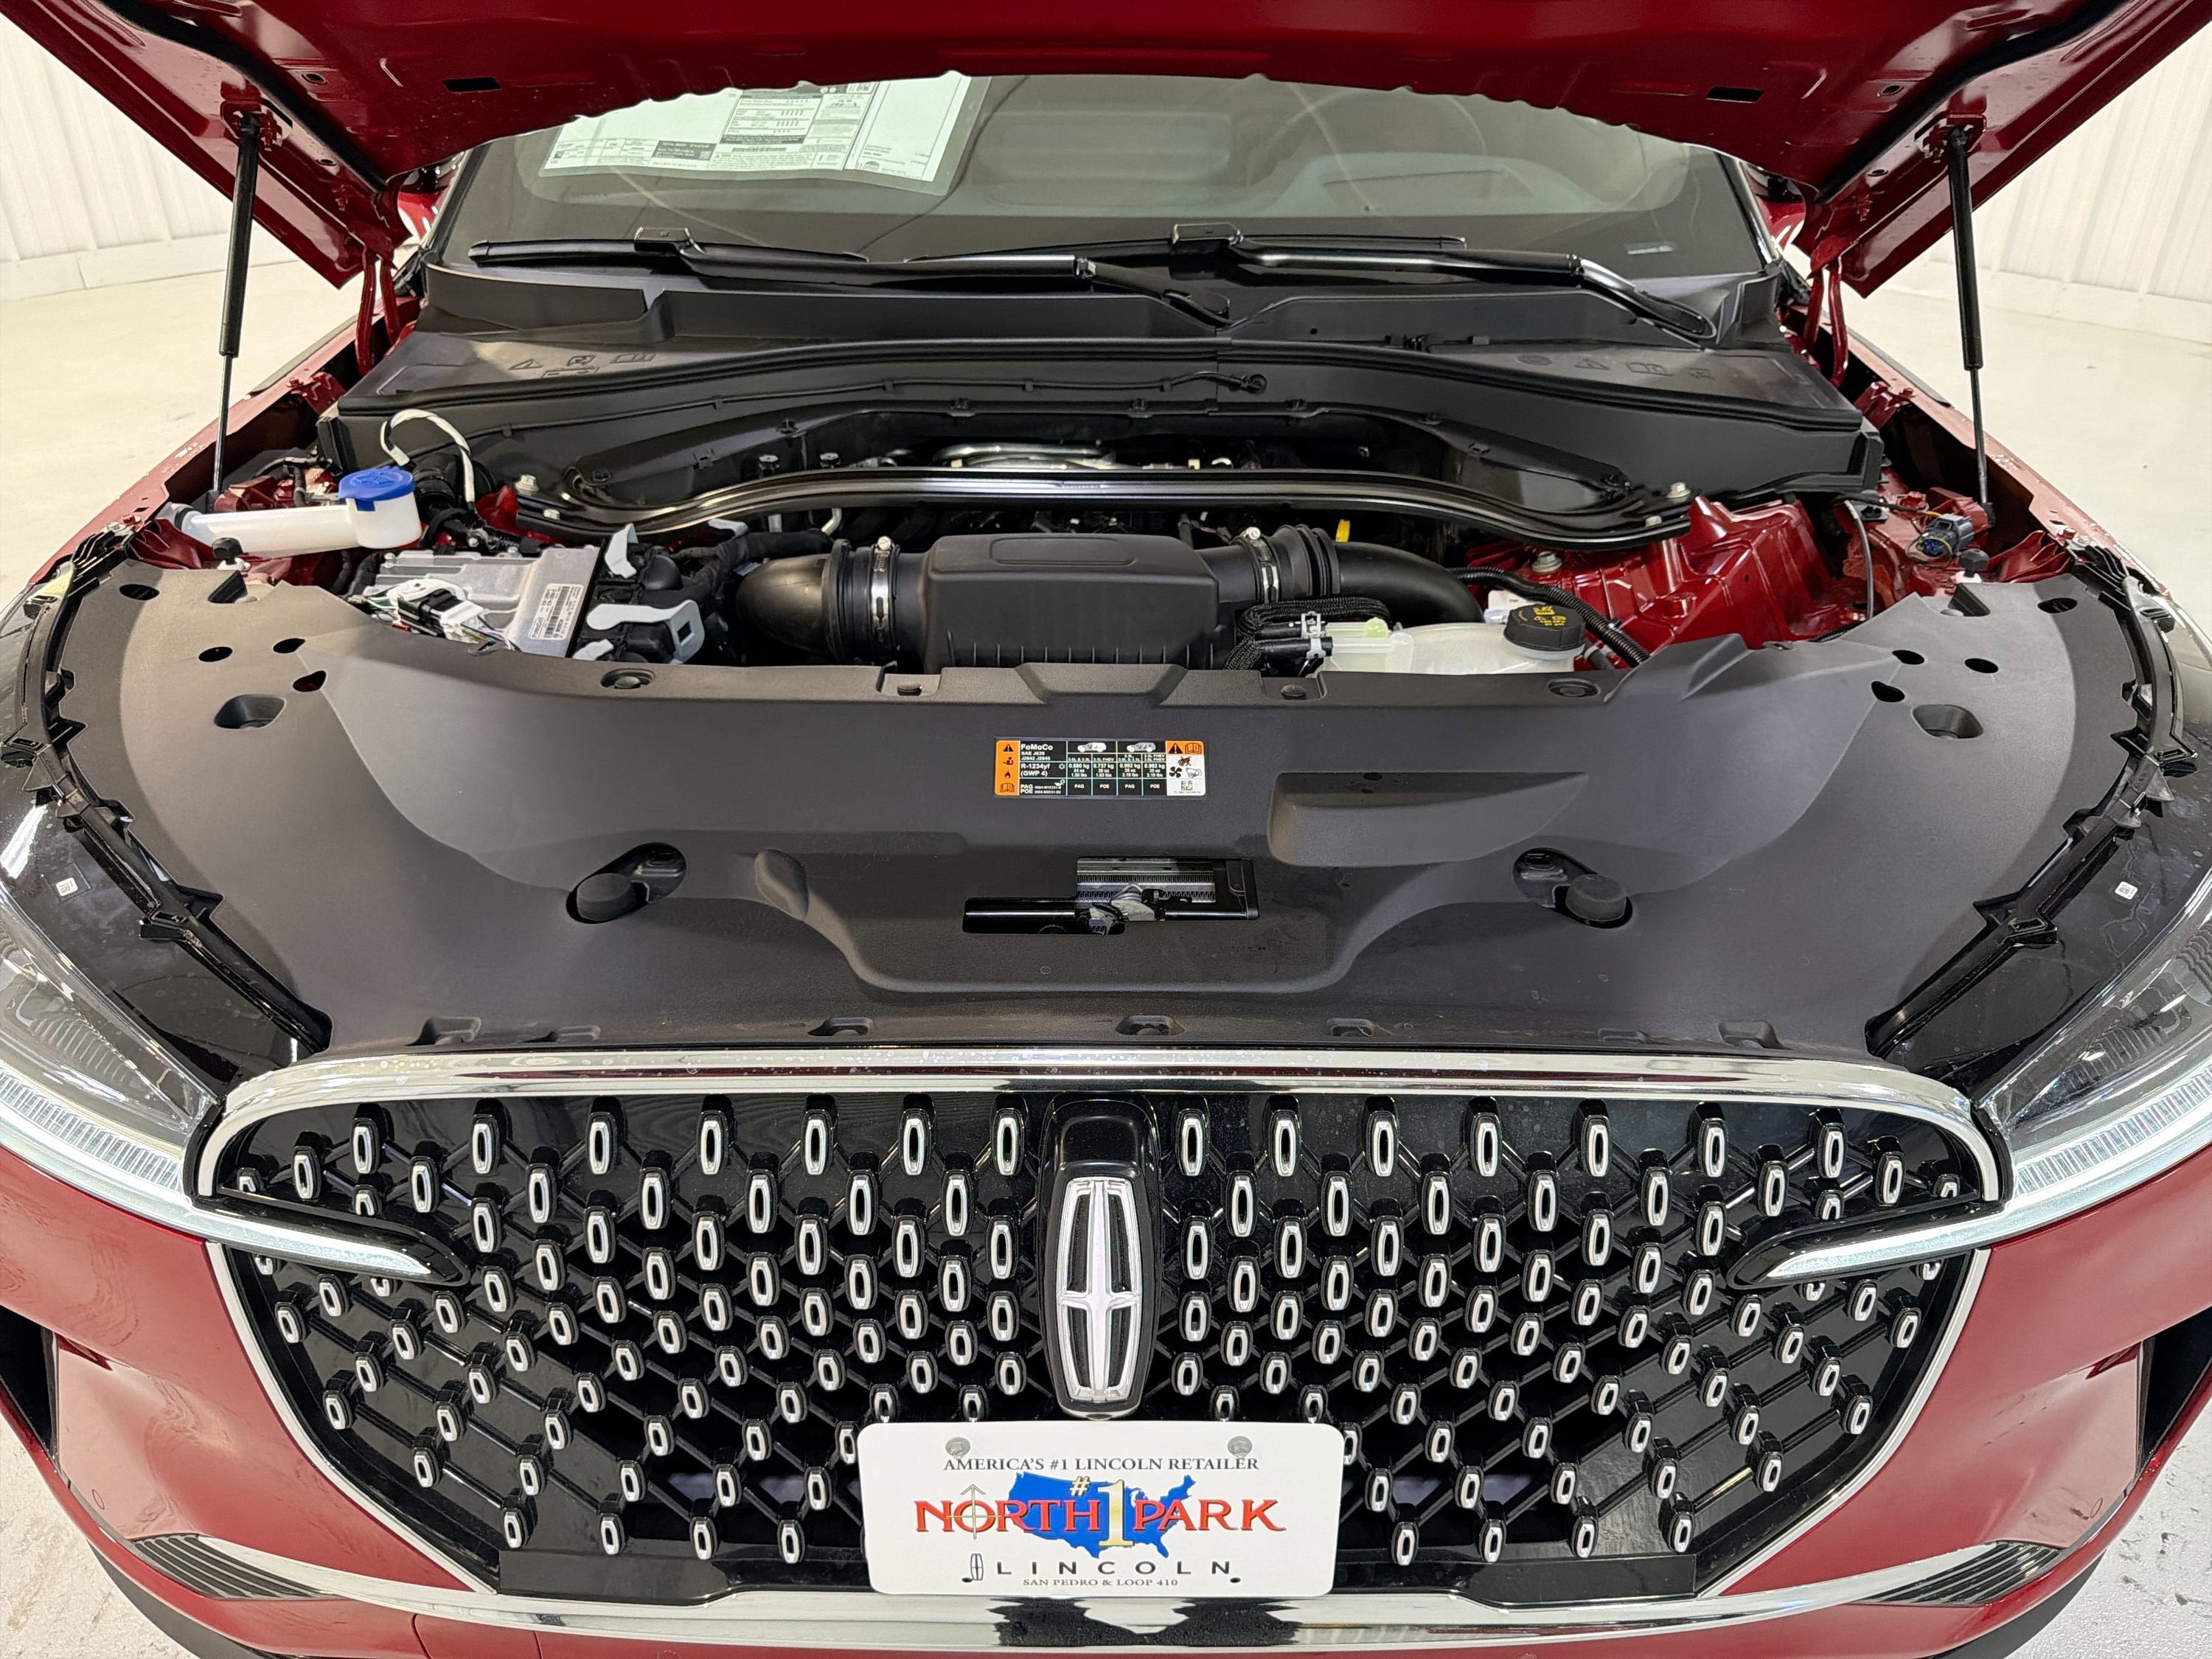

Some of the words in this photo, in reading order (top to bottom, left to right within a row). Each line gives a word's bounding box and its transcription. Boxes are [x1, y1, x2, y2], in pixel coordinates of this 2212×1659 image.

[1050, 1458, 1068, 1470] #1
[1074, 1458, 1163, 1470] LINCOLN
[1167, 1458, 1260, 1470] RETAILER
[914, 1499, 1102, 1533] NORTH
[1133, 1498, 1287, 1531] PARK
[997, 1561, 1230, 1575] LINCOLN
